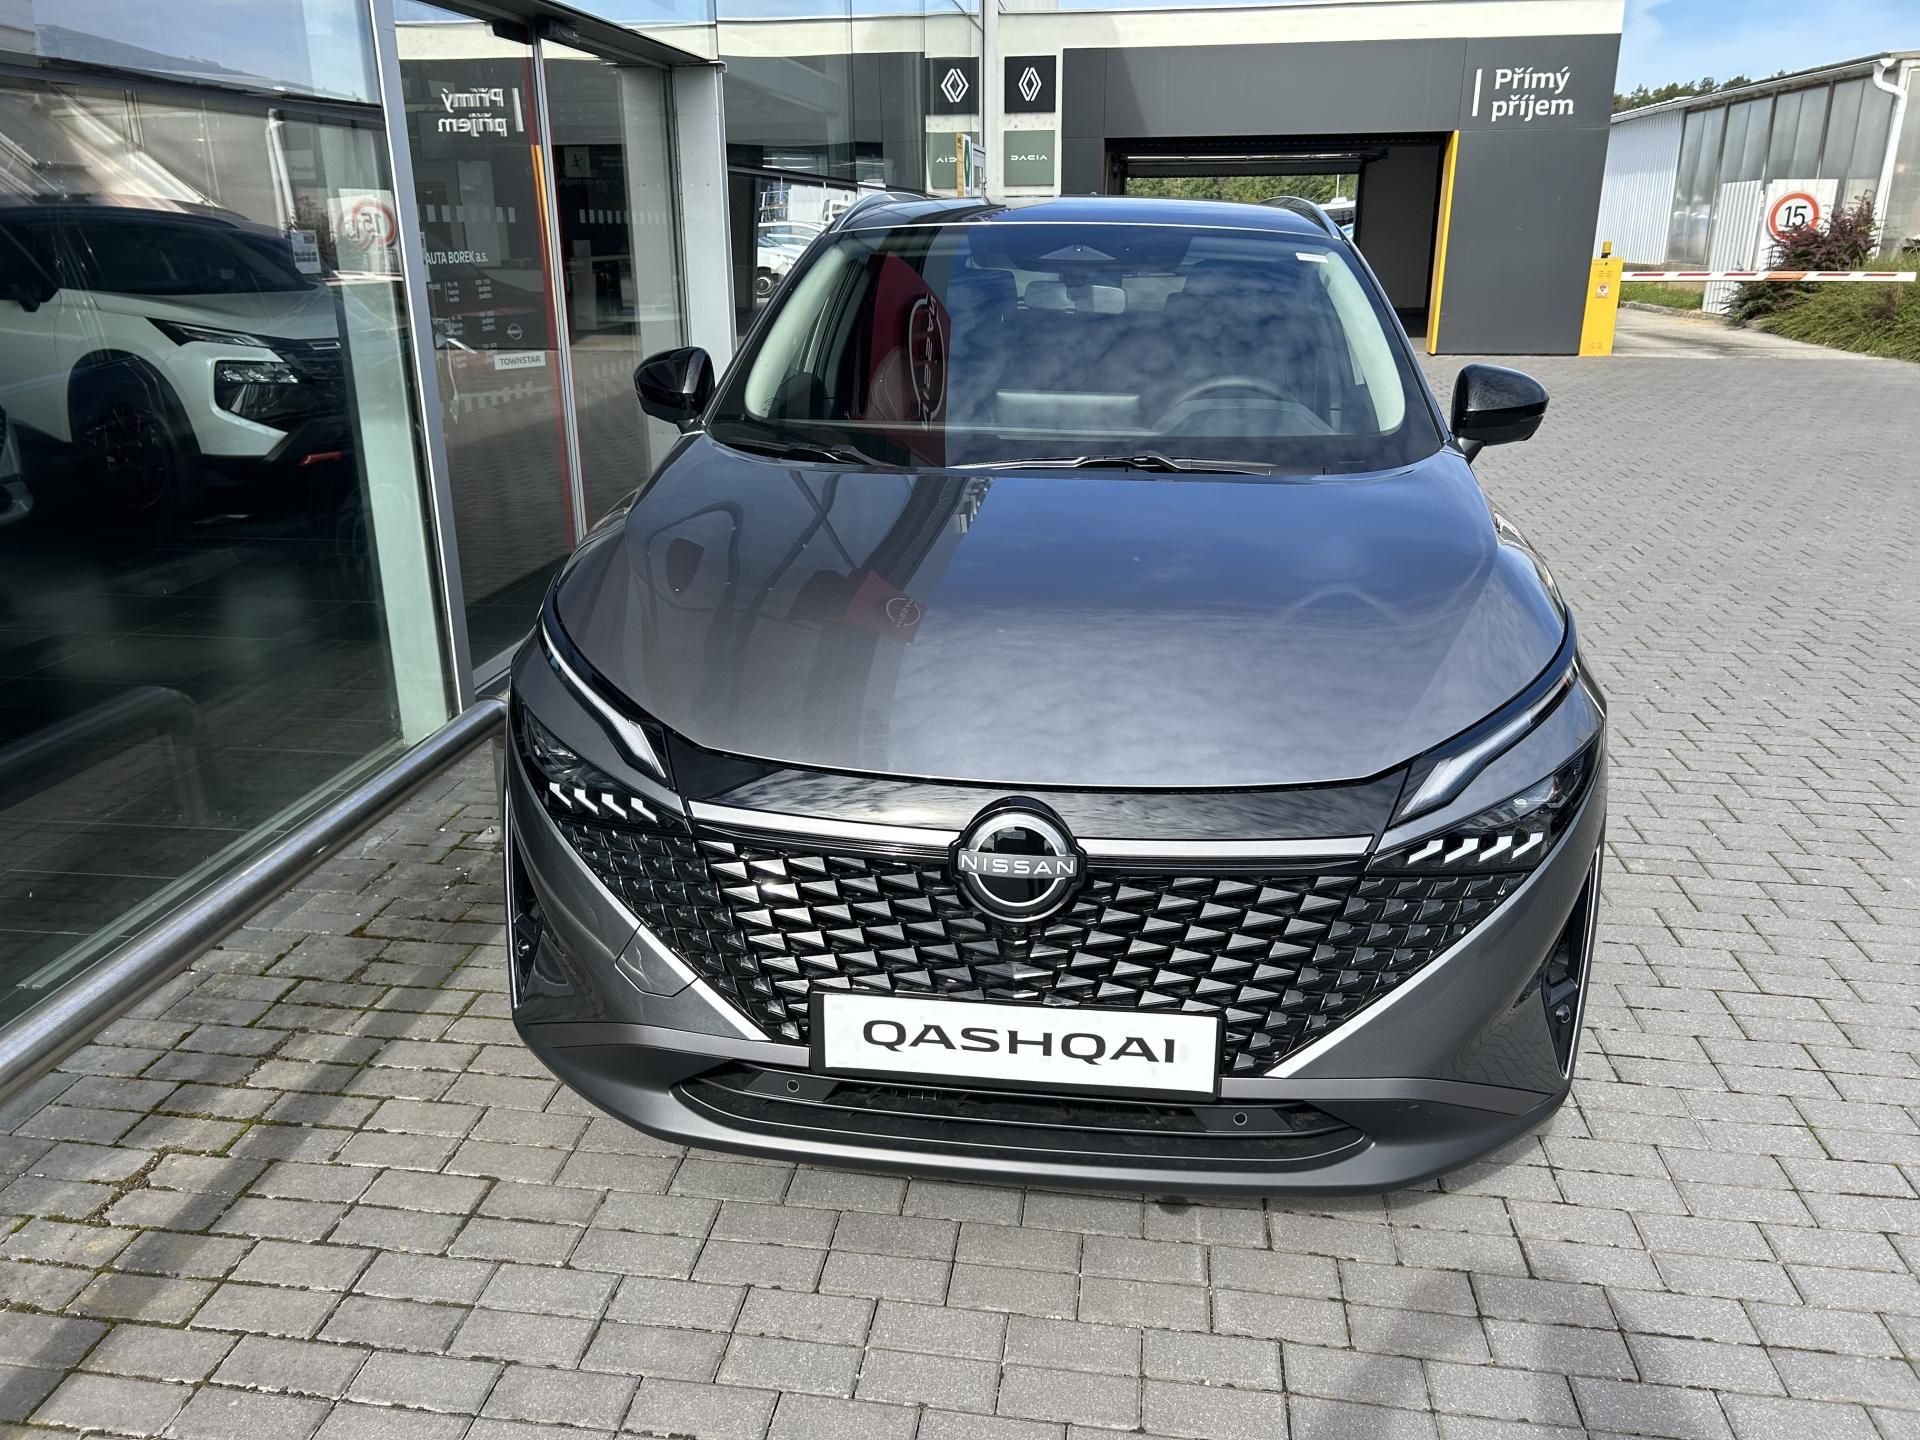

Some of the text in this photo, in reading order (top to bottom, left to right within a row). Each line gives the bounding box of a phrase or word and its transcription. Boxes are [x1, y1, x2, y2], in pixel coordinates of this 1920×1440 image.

[1495, 66, 1570, 94] Přímý
[1491, 94, 1574, 122] příjem
[1783, 205, 1807, 227] 15
[425, 252, 447, 265] AUTA
[448, 251, 475, 264] BOREK
[500, 356, 541, 366] TOWNSTAR
[961, 854, 1074, 875] NISSAN
[863, 1019, 1175, 1065] QASHQAI
